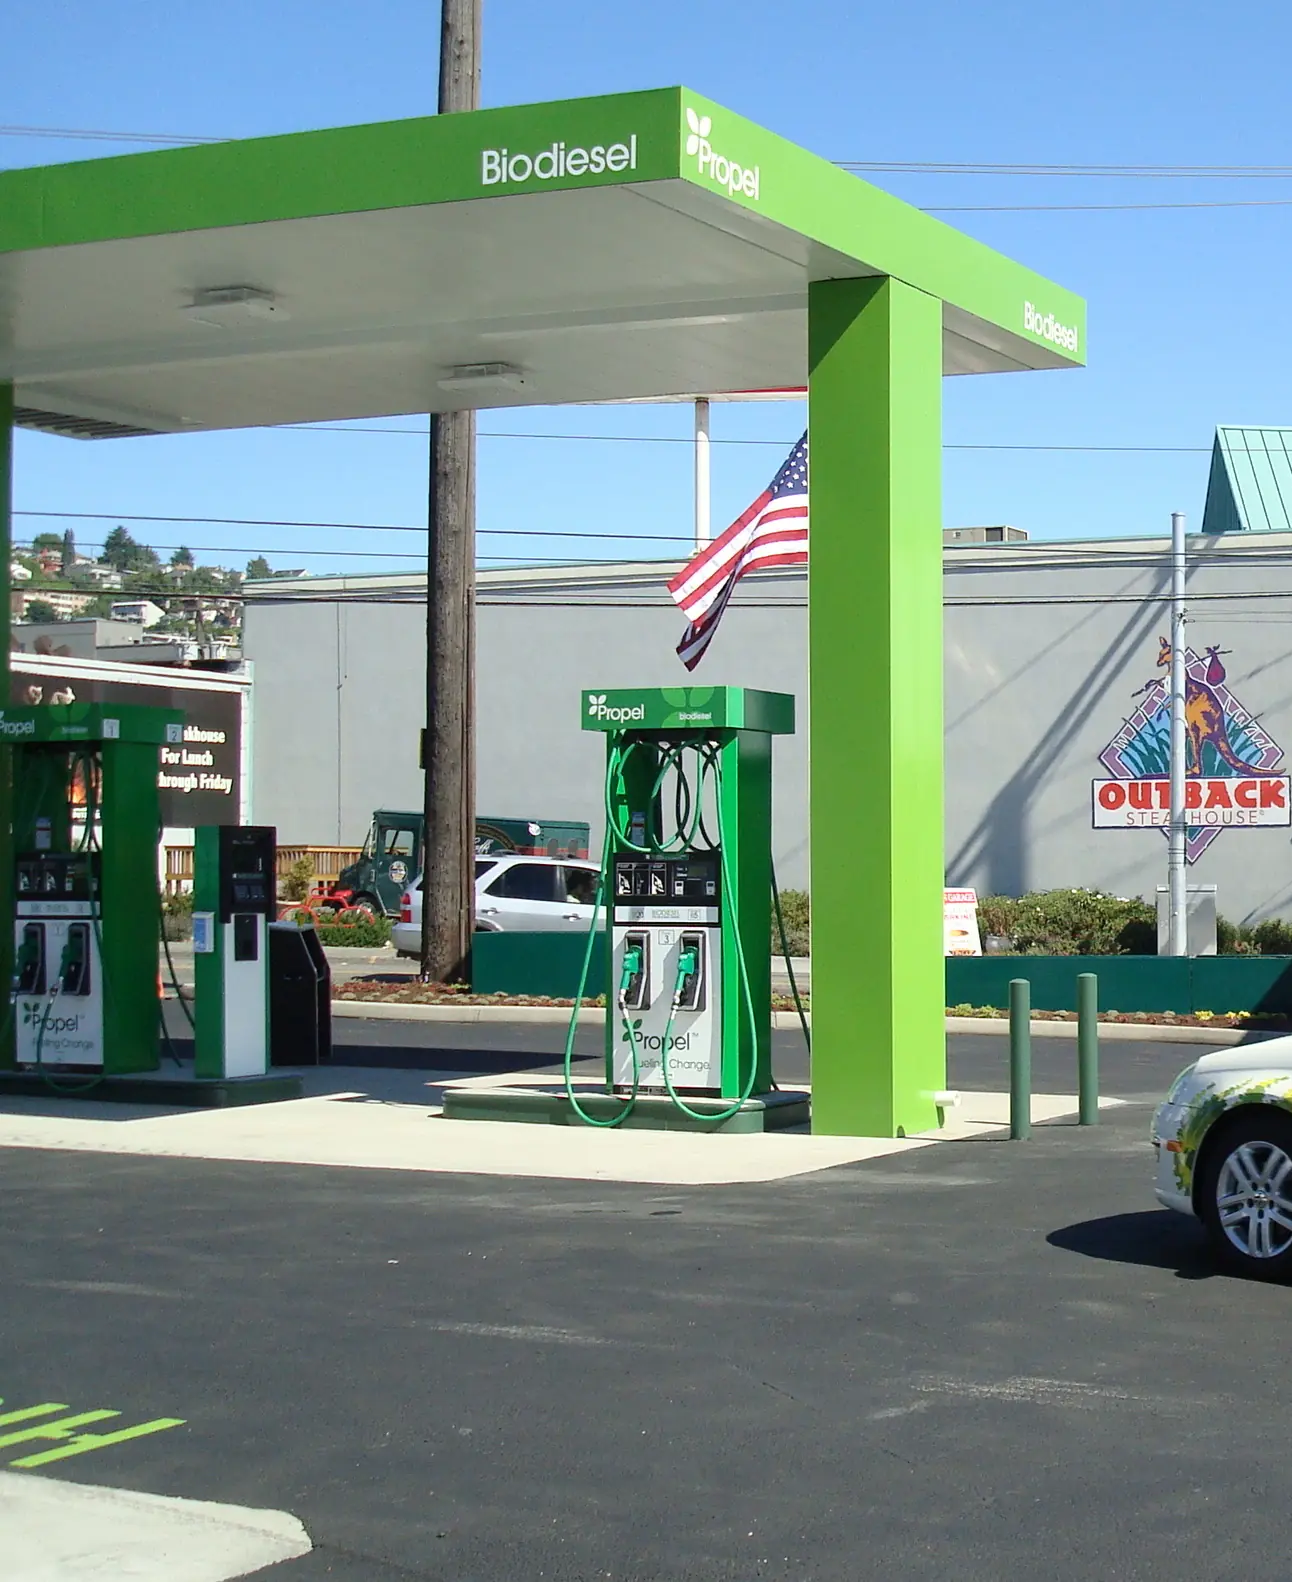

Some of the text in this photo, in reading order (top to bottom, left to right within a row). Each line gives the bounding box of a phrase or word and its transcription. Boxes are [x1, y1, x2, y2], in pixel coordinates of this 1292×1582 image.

[481, 134, 637, 185] Biodiesel
[698, 137, 760, 200] Propel
[1024, 300, 1078, 352] Biodiesel
[597, 703, 645, 723] Propel
[0, 718, 35, 736] Propel
[161, 747, 213, 766] For Lunch
[158, 771, 233, 794] hrough Friday
[1098, 780, 1286, 811] OUTBACK
[1126, 810, 1258, 825] STEAHOUSE
